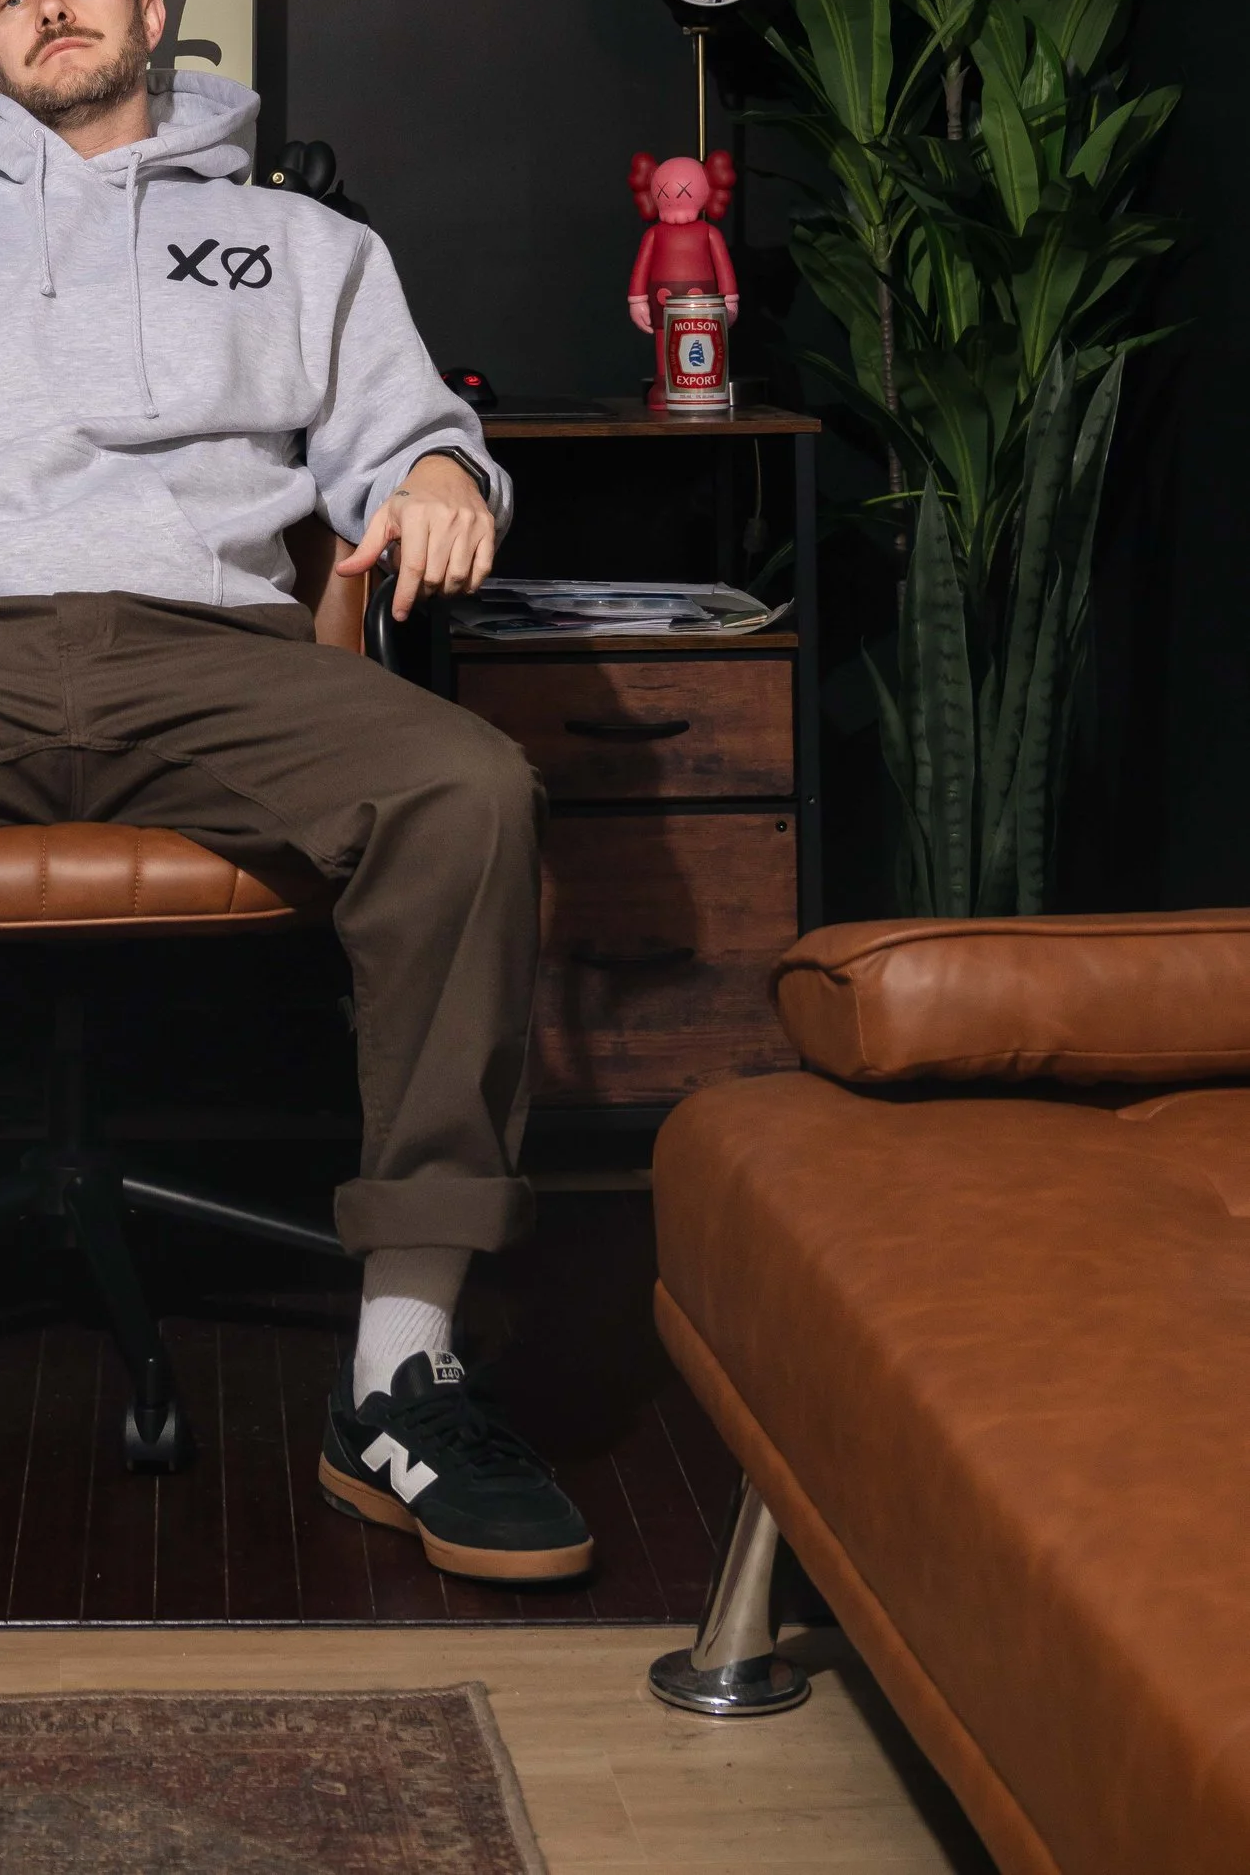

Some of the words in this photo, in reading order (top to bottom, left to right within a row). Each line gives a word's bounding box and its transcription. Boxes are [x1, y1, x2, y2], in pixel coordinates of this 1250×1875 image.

[674, 321, 718, 332] MOLSON
[676, 374, 717, 386] EXPORT
[441, 1368, 460, 1379] 440
